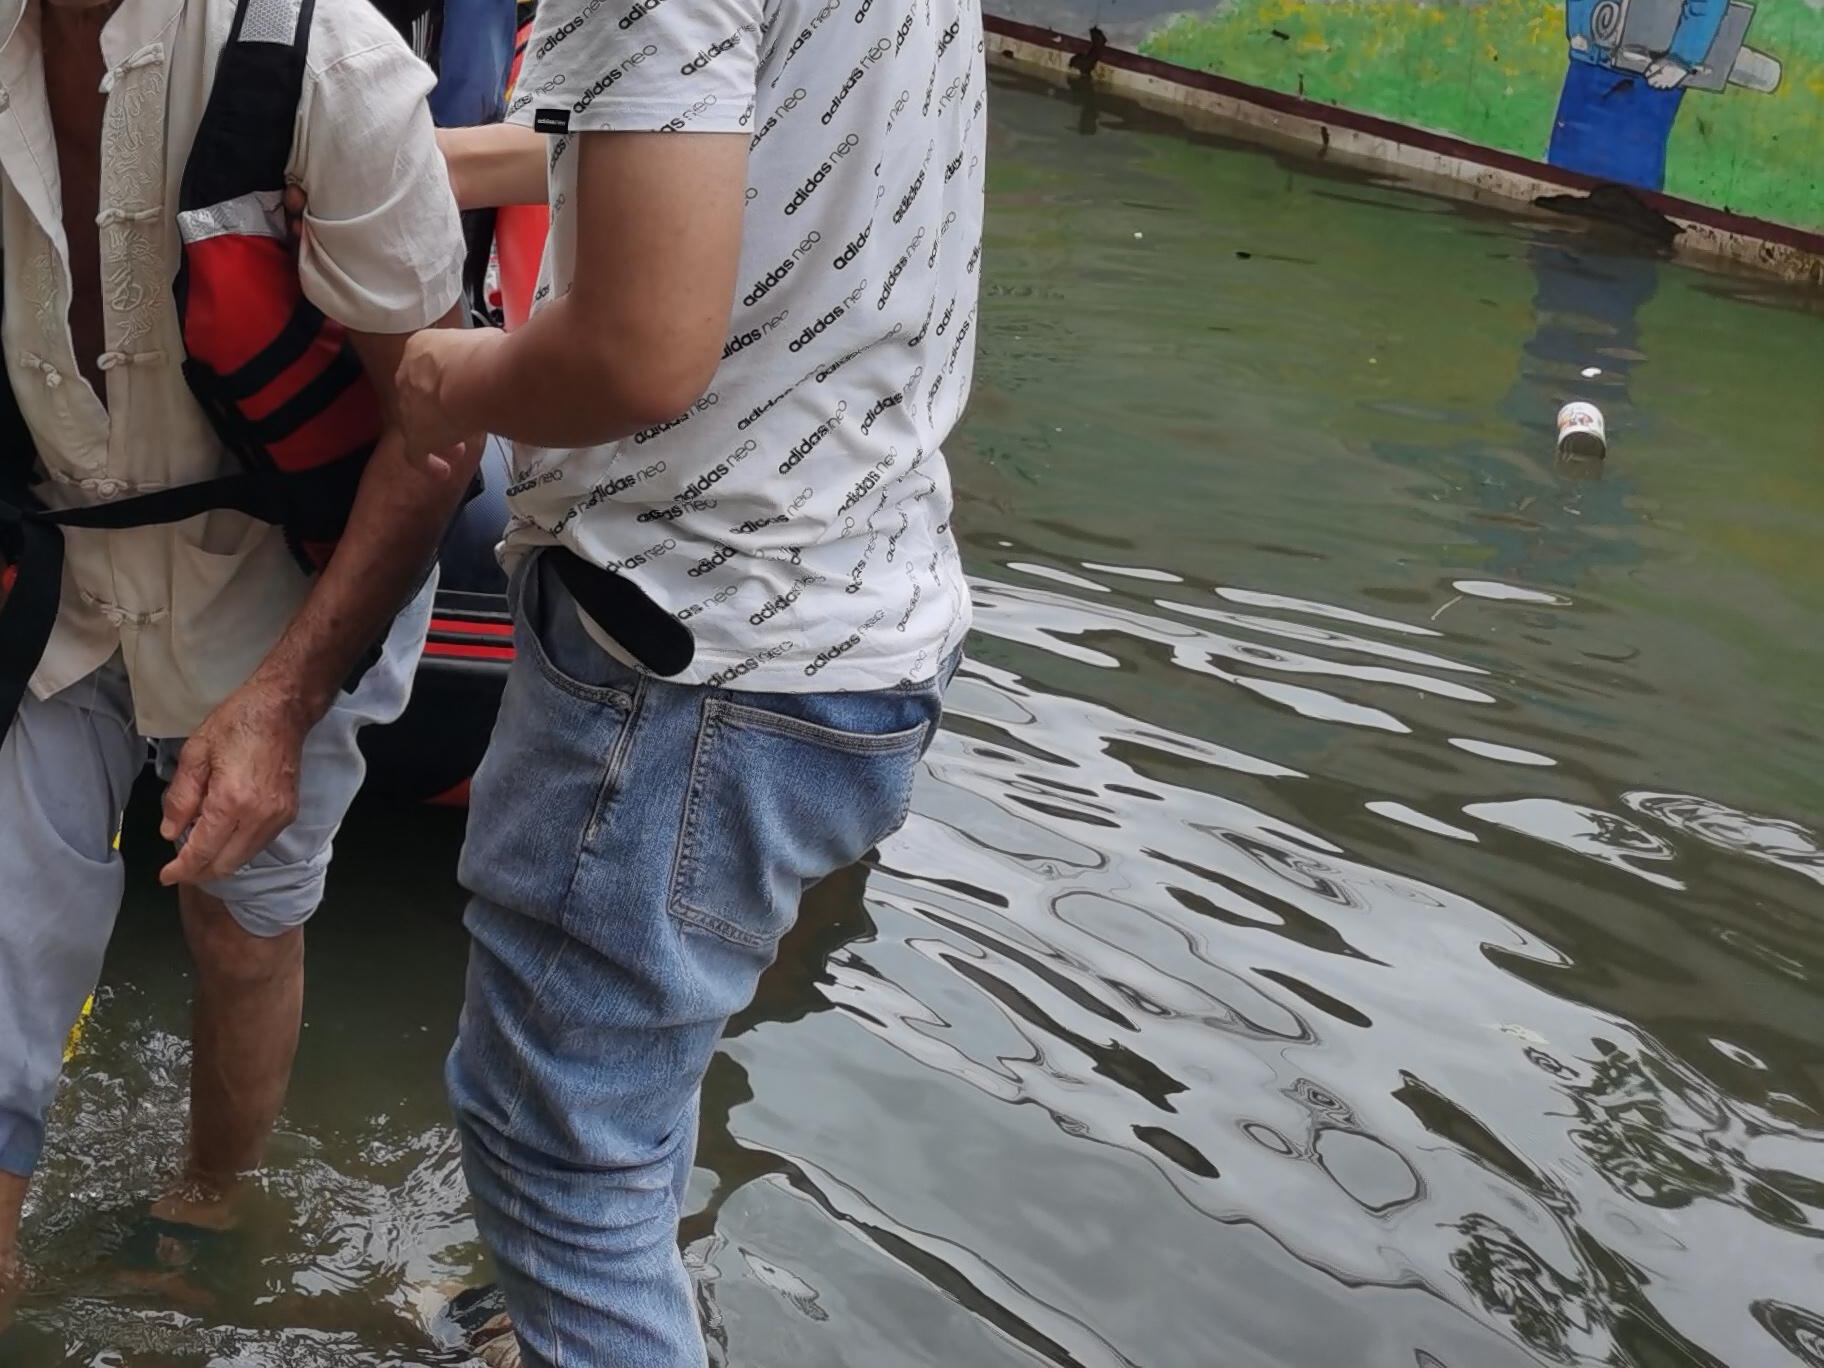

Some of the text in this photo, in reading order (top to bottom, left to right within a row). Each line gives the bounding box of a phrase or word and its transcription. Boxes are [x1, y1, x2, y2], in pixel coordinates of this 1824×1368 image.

[536, 15, 584, 60] adidas
[534, 73, 566, 97] neo
[573, 44, 658, 114] adidas neo
[821, 37, 892, 125] adidas neo
[775, 88, 807, 119] neo
[784, 133, 859, 216] adidas neo
[743, 230, 821, 308] adidas neo
[877, 226, 926, 311] adidas neo
[761, 309, 789, 335] neo
[789, 279, 869, 353] adidas neo
[636, 460, 667, 482] neo
[726, 439, 757, 468] neo
[778, 423, 828, 476] adidas
[787, 487, 813, 517] neo
[702, 585, 738, 610] neo
[804, 635, 861, 677] adidas
